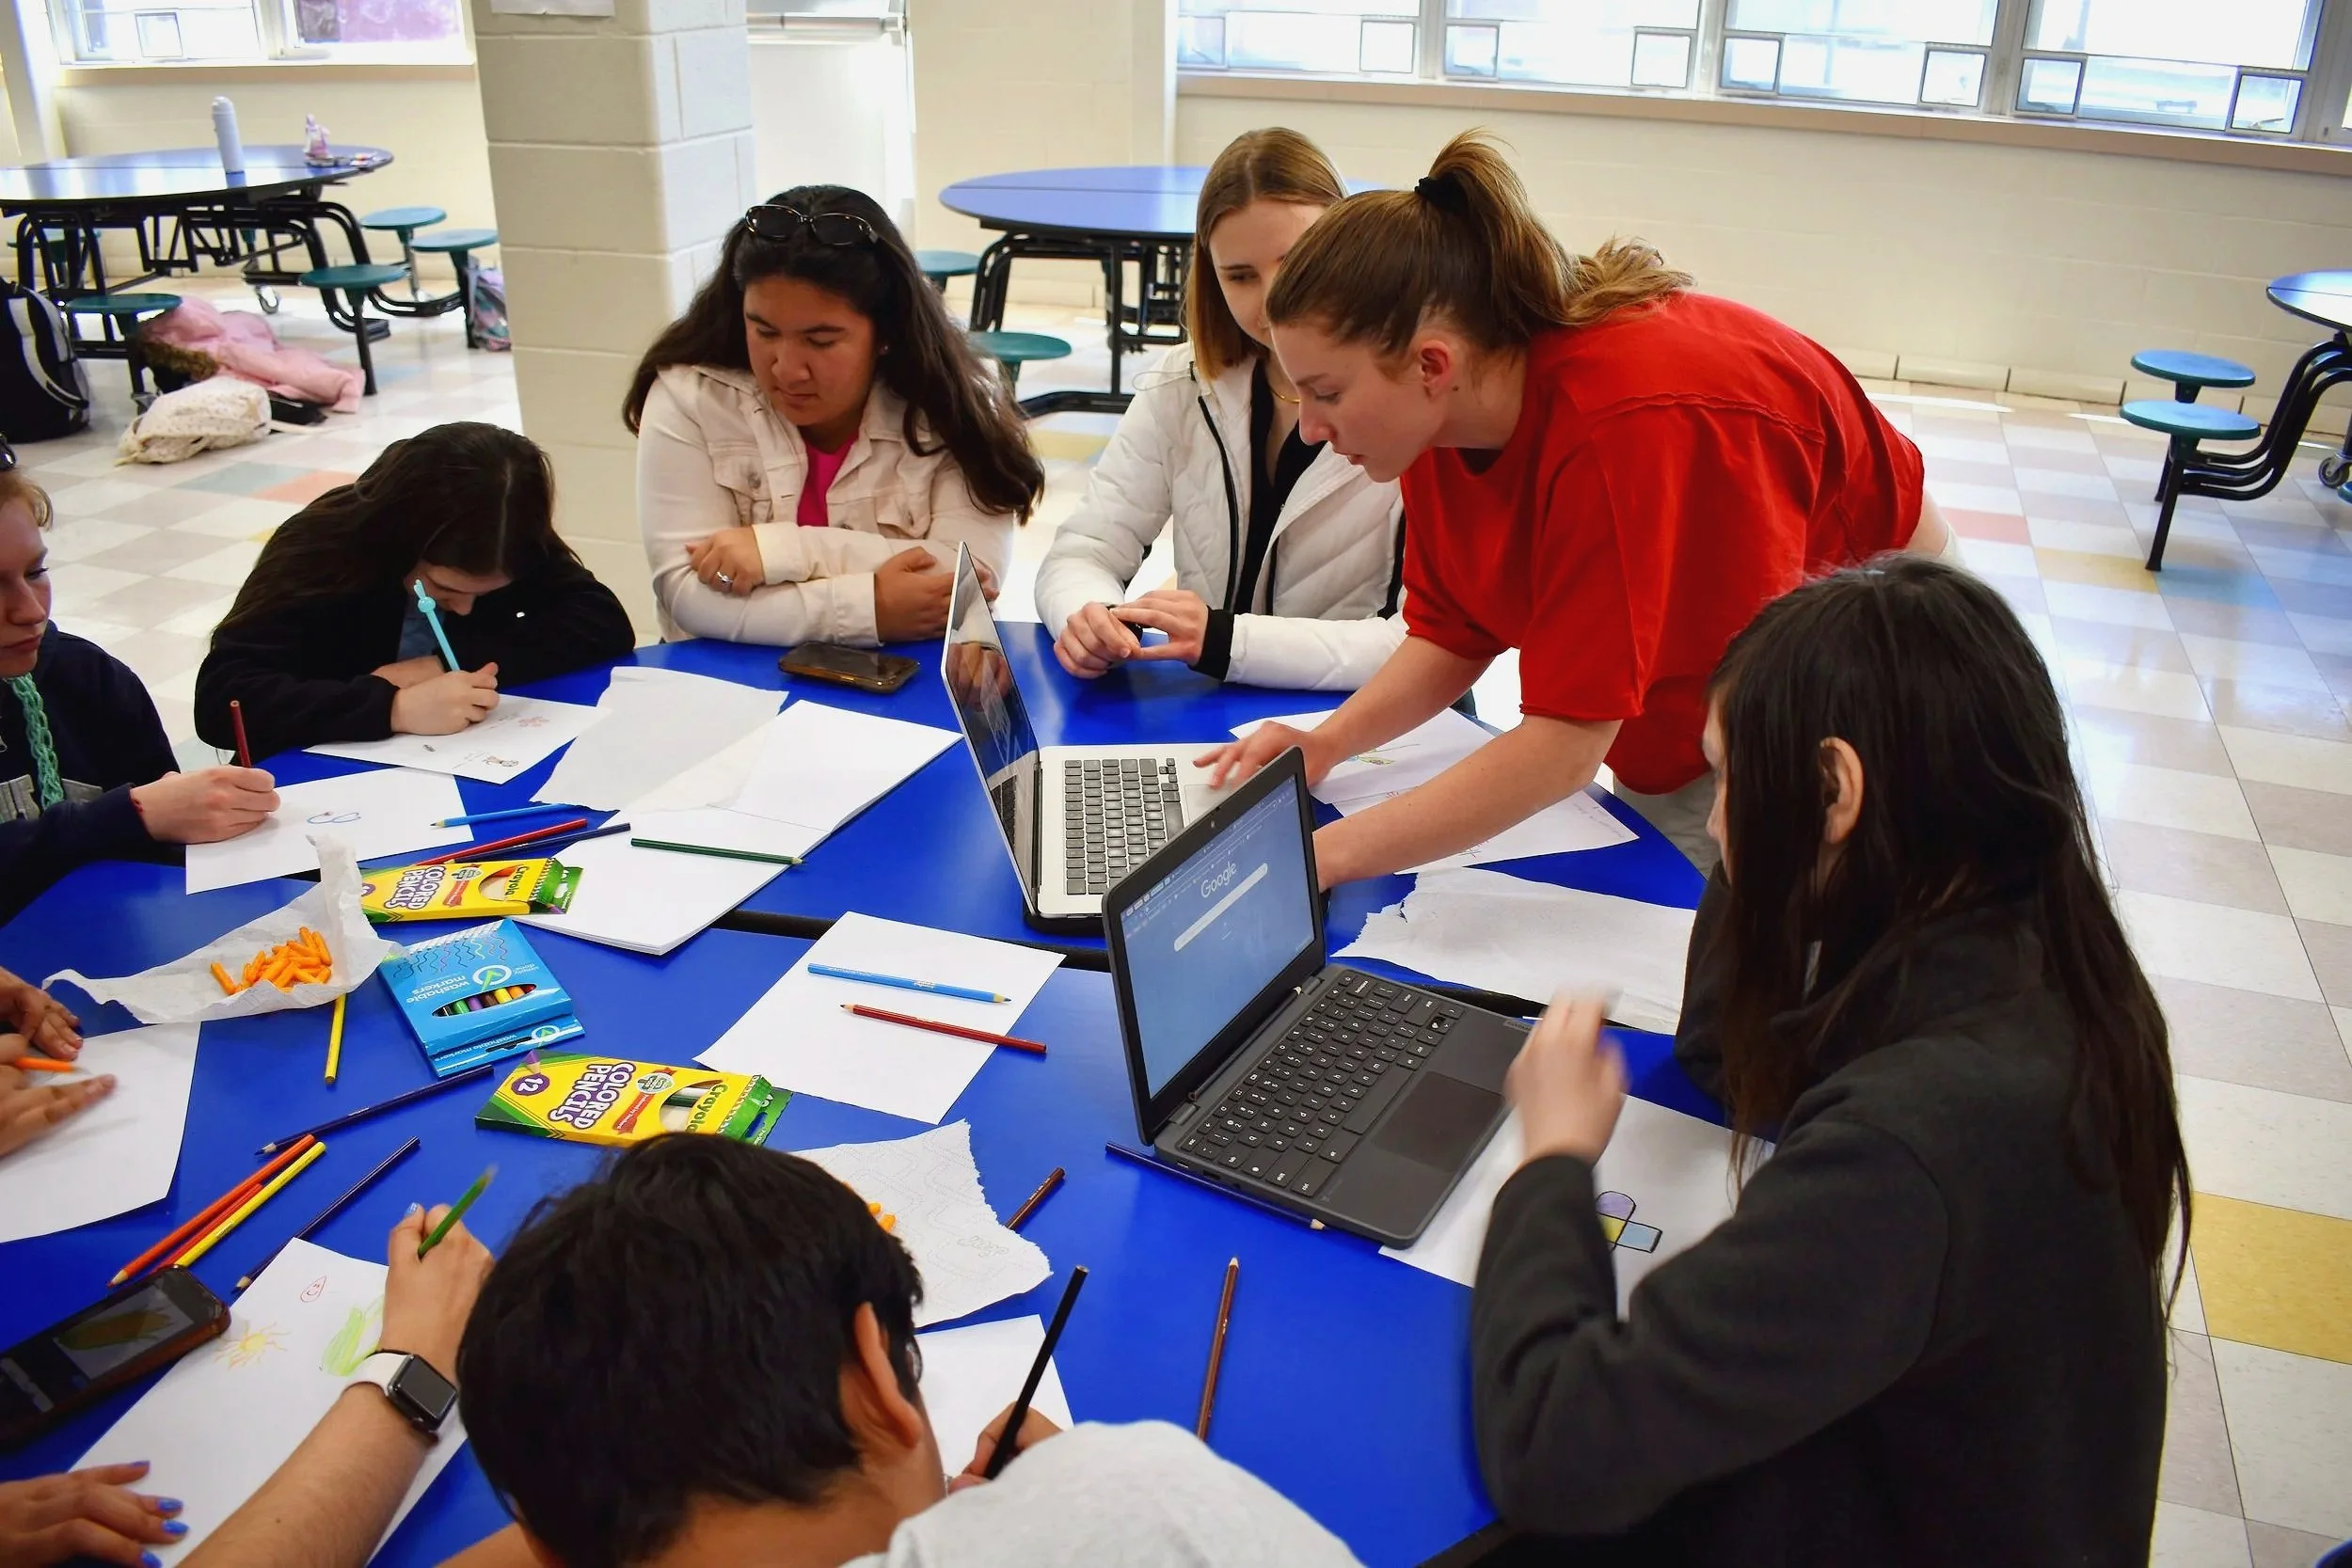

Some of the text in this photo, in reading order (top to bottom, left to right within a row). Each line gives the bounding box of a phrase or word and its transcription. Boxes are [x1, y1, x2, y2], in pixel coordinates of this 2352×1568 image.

[384, 869, 425, 909] PENCILS
[407, 865, 446, 910] COLORED
[505, 865, 529, 896] Crayola
[1200, 861, 1237, 898] Google
[405, 981, 470, 1004] washable
[411, 975, 467, 996] markers
[434, 1034, 517, 1062] washable markers
[517, 1078, 544, 1092] 12
[548, 1064, 612, 1122] PENCILS
[572, 1062, 636, 1129] COLORED
[685, 1084, 728, 1133] Crayola
